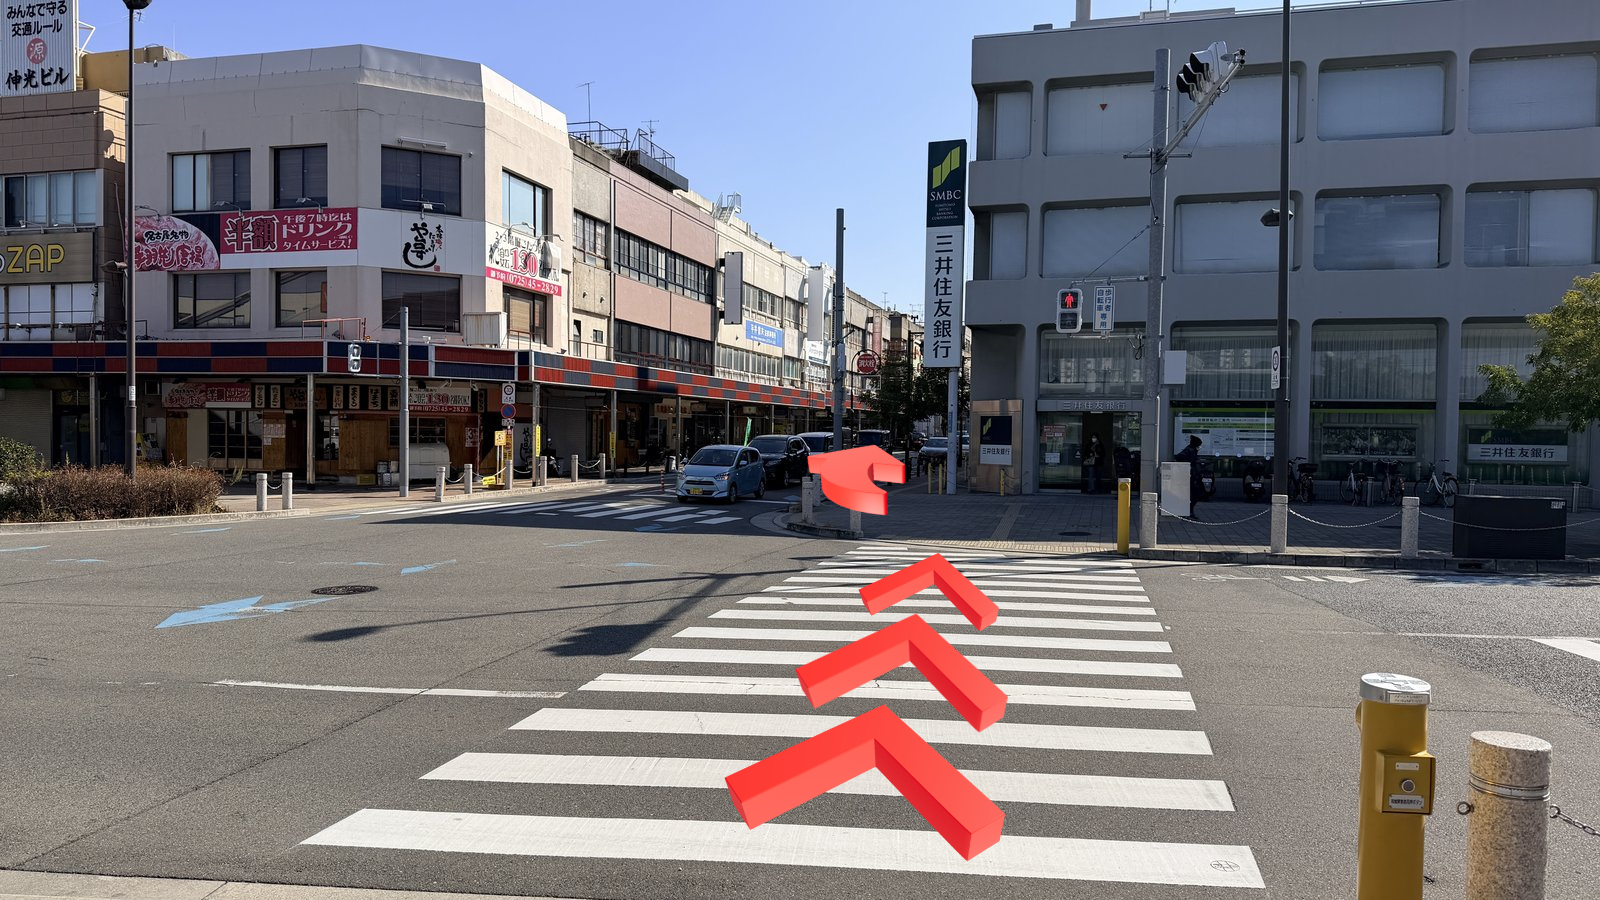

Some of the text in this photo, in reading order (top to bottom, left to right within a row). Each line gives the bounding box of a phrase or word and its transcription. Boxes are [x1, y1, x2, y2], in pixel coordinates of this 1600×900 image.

[6, 1, 68, 20] みんなで守る
[11, 19, 63, 37] 交通ルール
[5, 67, 70, 91] 伸光ビル
[930, 189, 961, 201] SMBC
[224, 215, 279, 252] 半額
[282, 222, 353, 238] ドリンク
[510, 247, 538, 277] 130
[933, 234, 954, 359] 三井住友銀行
[1104, 289, 1112, 312] 歩行者
[1099, 313, 1107, 328] 専用
[858, 359, 875, 368] 消火栓
[1063, 401, 1127, 411] 三井住友銀行
[982, 446, 1011, 456] 三井住友銀行
[1480, 447, 1555, 459] 三井住友銀行
